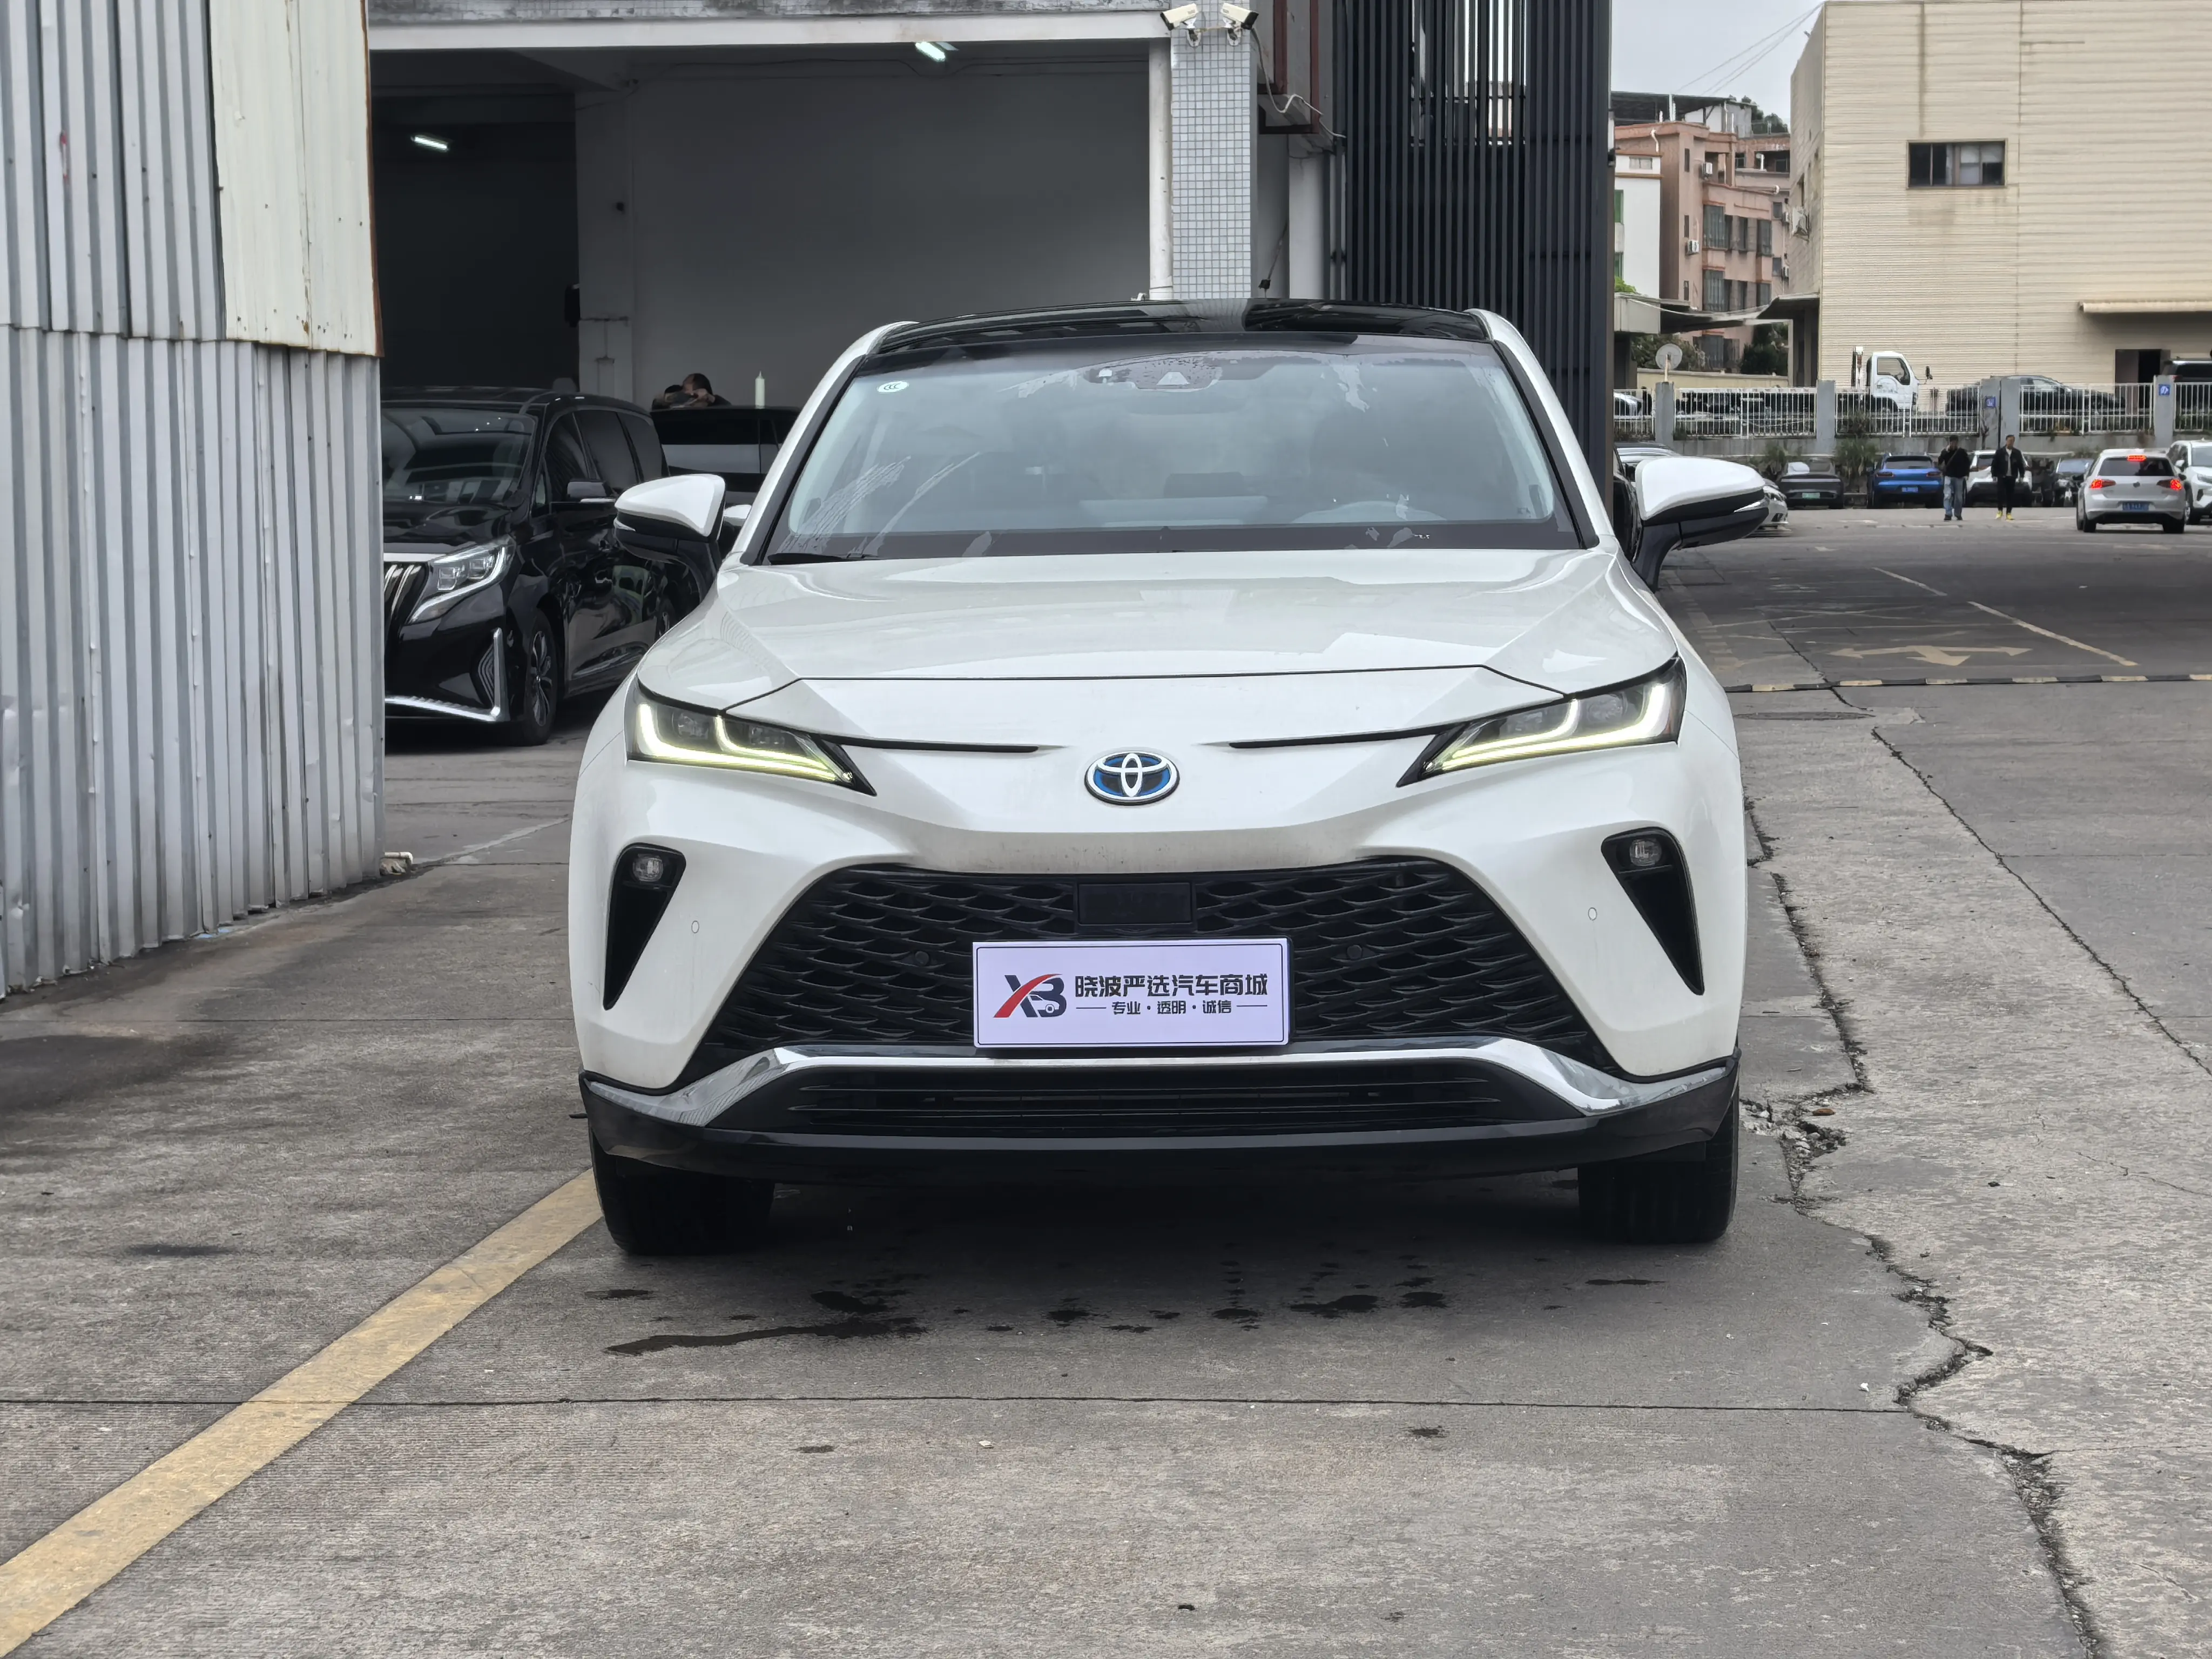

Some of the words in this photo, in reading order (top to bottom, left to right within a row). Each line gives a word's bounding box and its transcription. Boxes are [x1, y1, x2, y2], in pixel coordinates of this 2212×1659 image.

[1075, 973, 1268, 997] 晓波严选汽车商城
